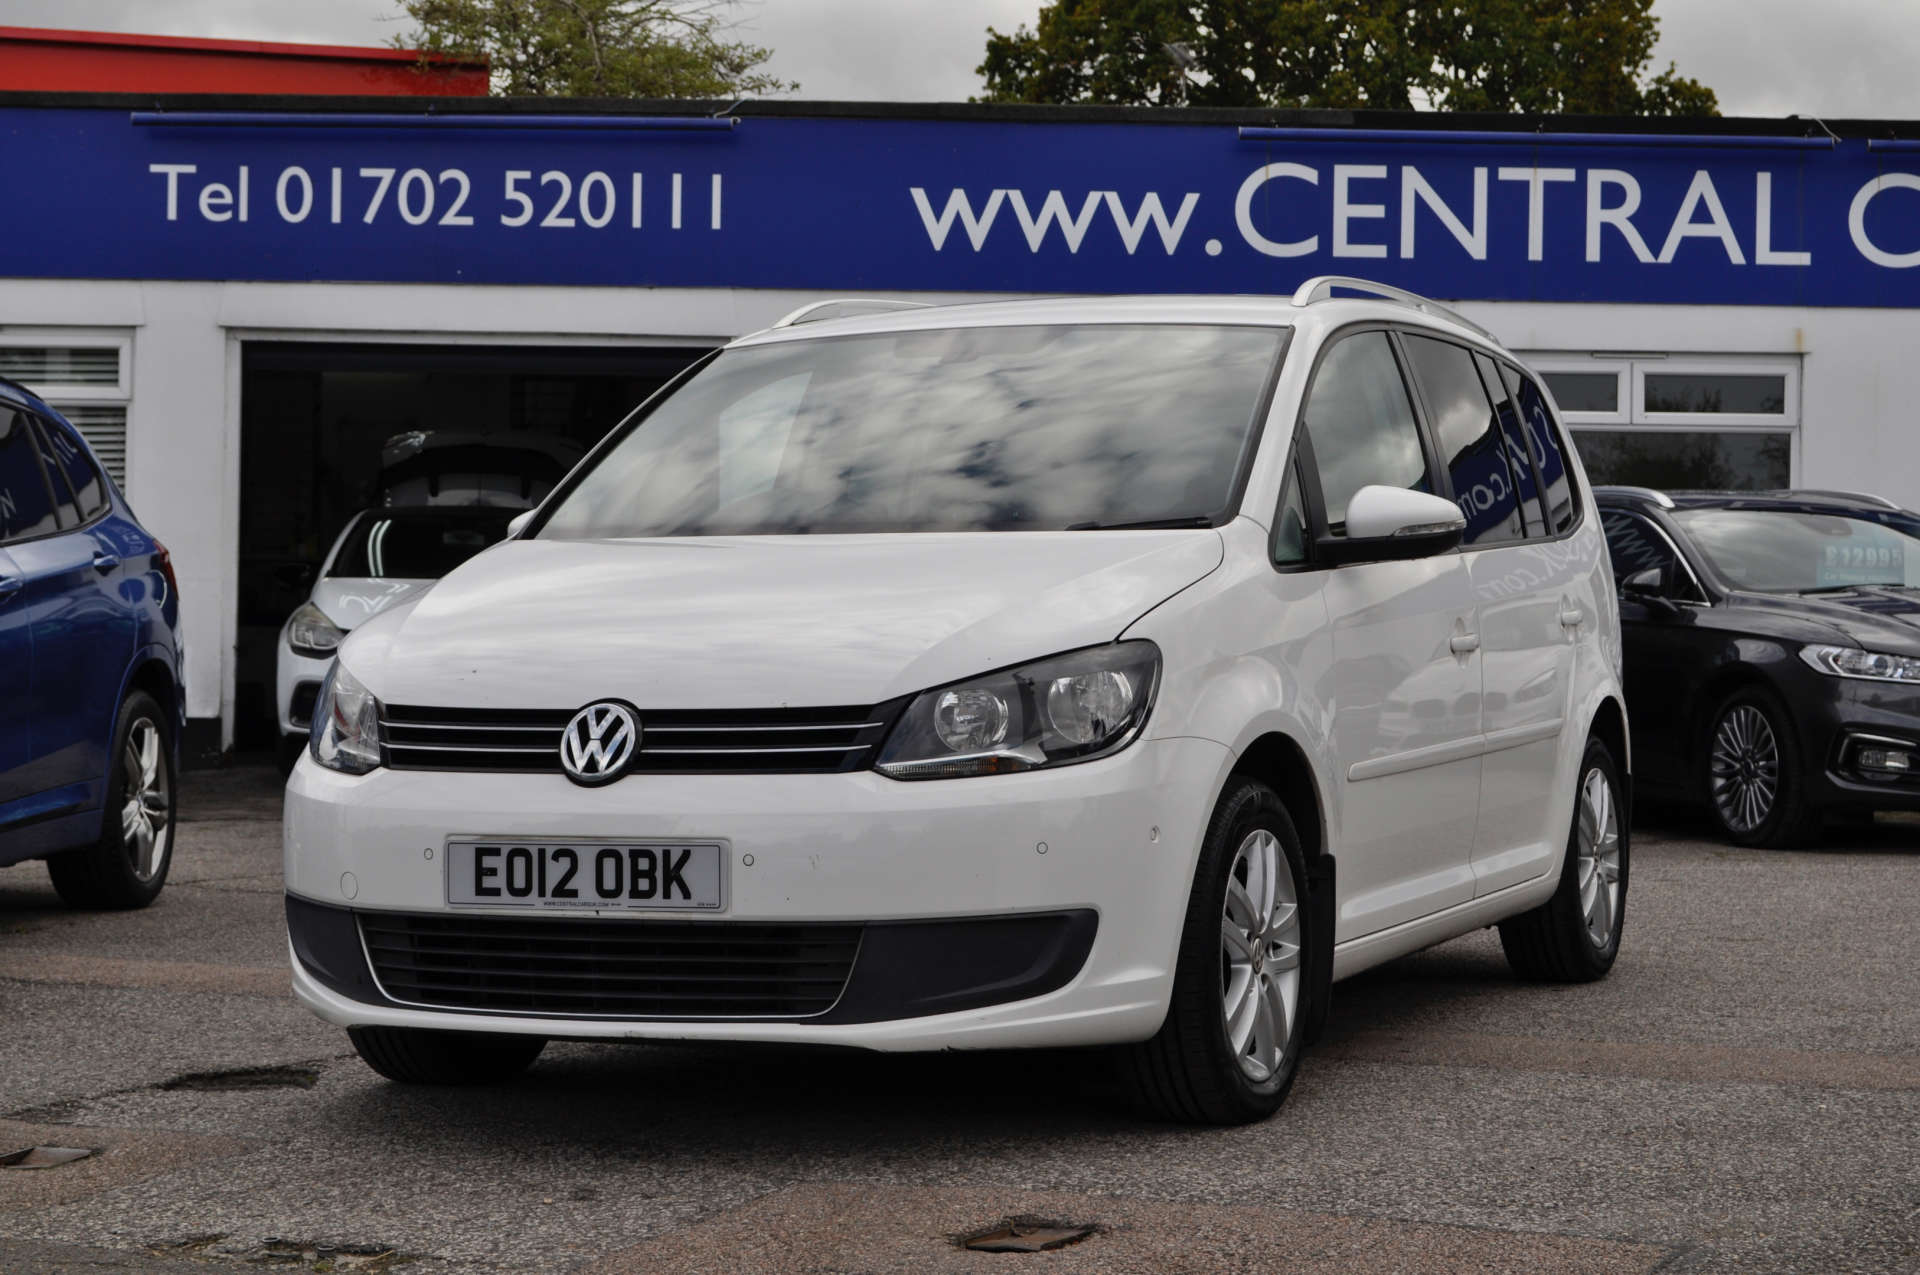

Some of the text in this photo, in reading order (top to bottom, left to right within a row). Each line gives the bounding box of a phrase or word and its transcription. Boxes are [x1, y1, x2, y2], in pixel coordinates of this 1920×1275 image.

[150, 164, 722, 230] Tel 01702 520111
[910, 162, 1812, 266] www.CENTRAL
[474, 846, 692, 900] EO12 OBK
